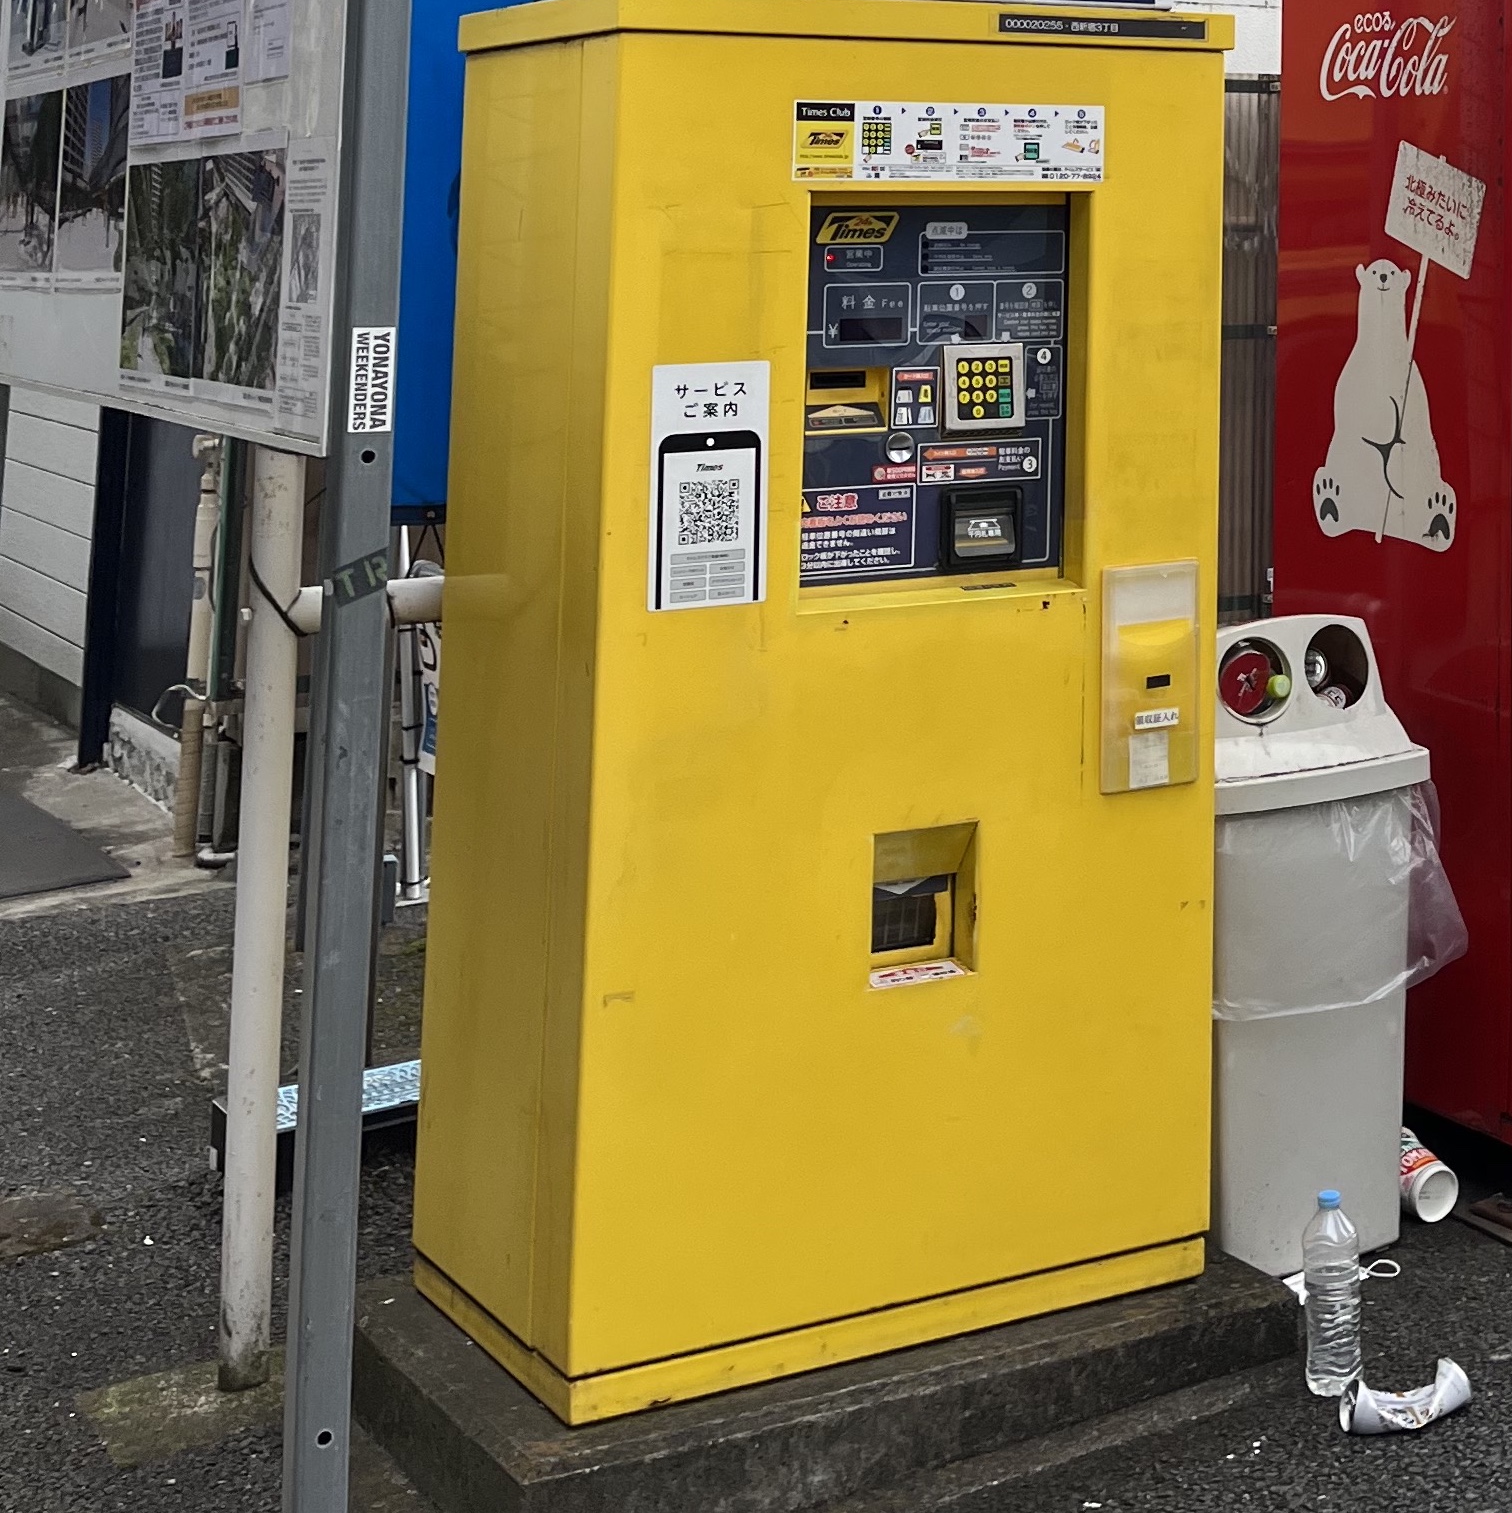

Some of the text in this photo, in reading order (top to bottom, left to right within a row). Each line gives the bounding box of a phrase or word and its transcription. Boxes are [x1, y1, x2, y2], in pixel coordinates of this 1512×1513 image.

[1320, 15, 1457, 101] Coca-Cola
[801, 107, 851, 117] Times Club
[1405, 175, 1468, 221] 北極みたいに
[829, 220, 888, 241] Times
[841, 295, 904, 310] 料金 Fee
[352, 331, 370, 431] WEEKENDERS
[369, 331, 391, 430] YONAYONA
[674, 381, 747, 399] サービス
[684, 401, 739, 419] ご案内
